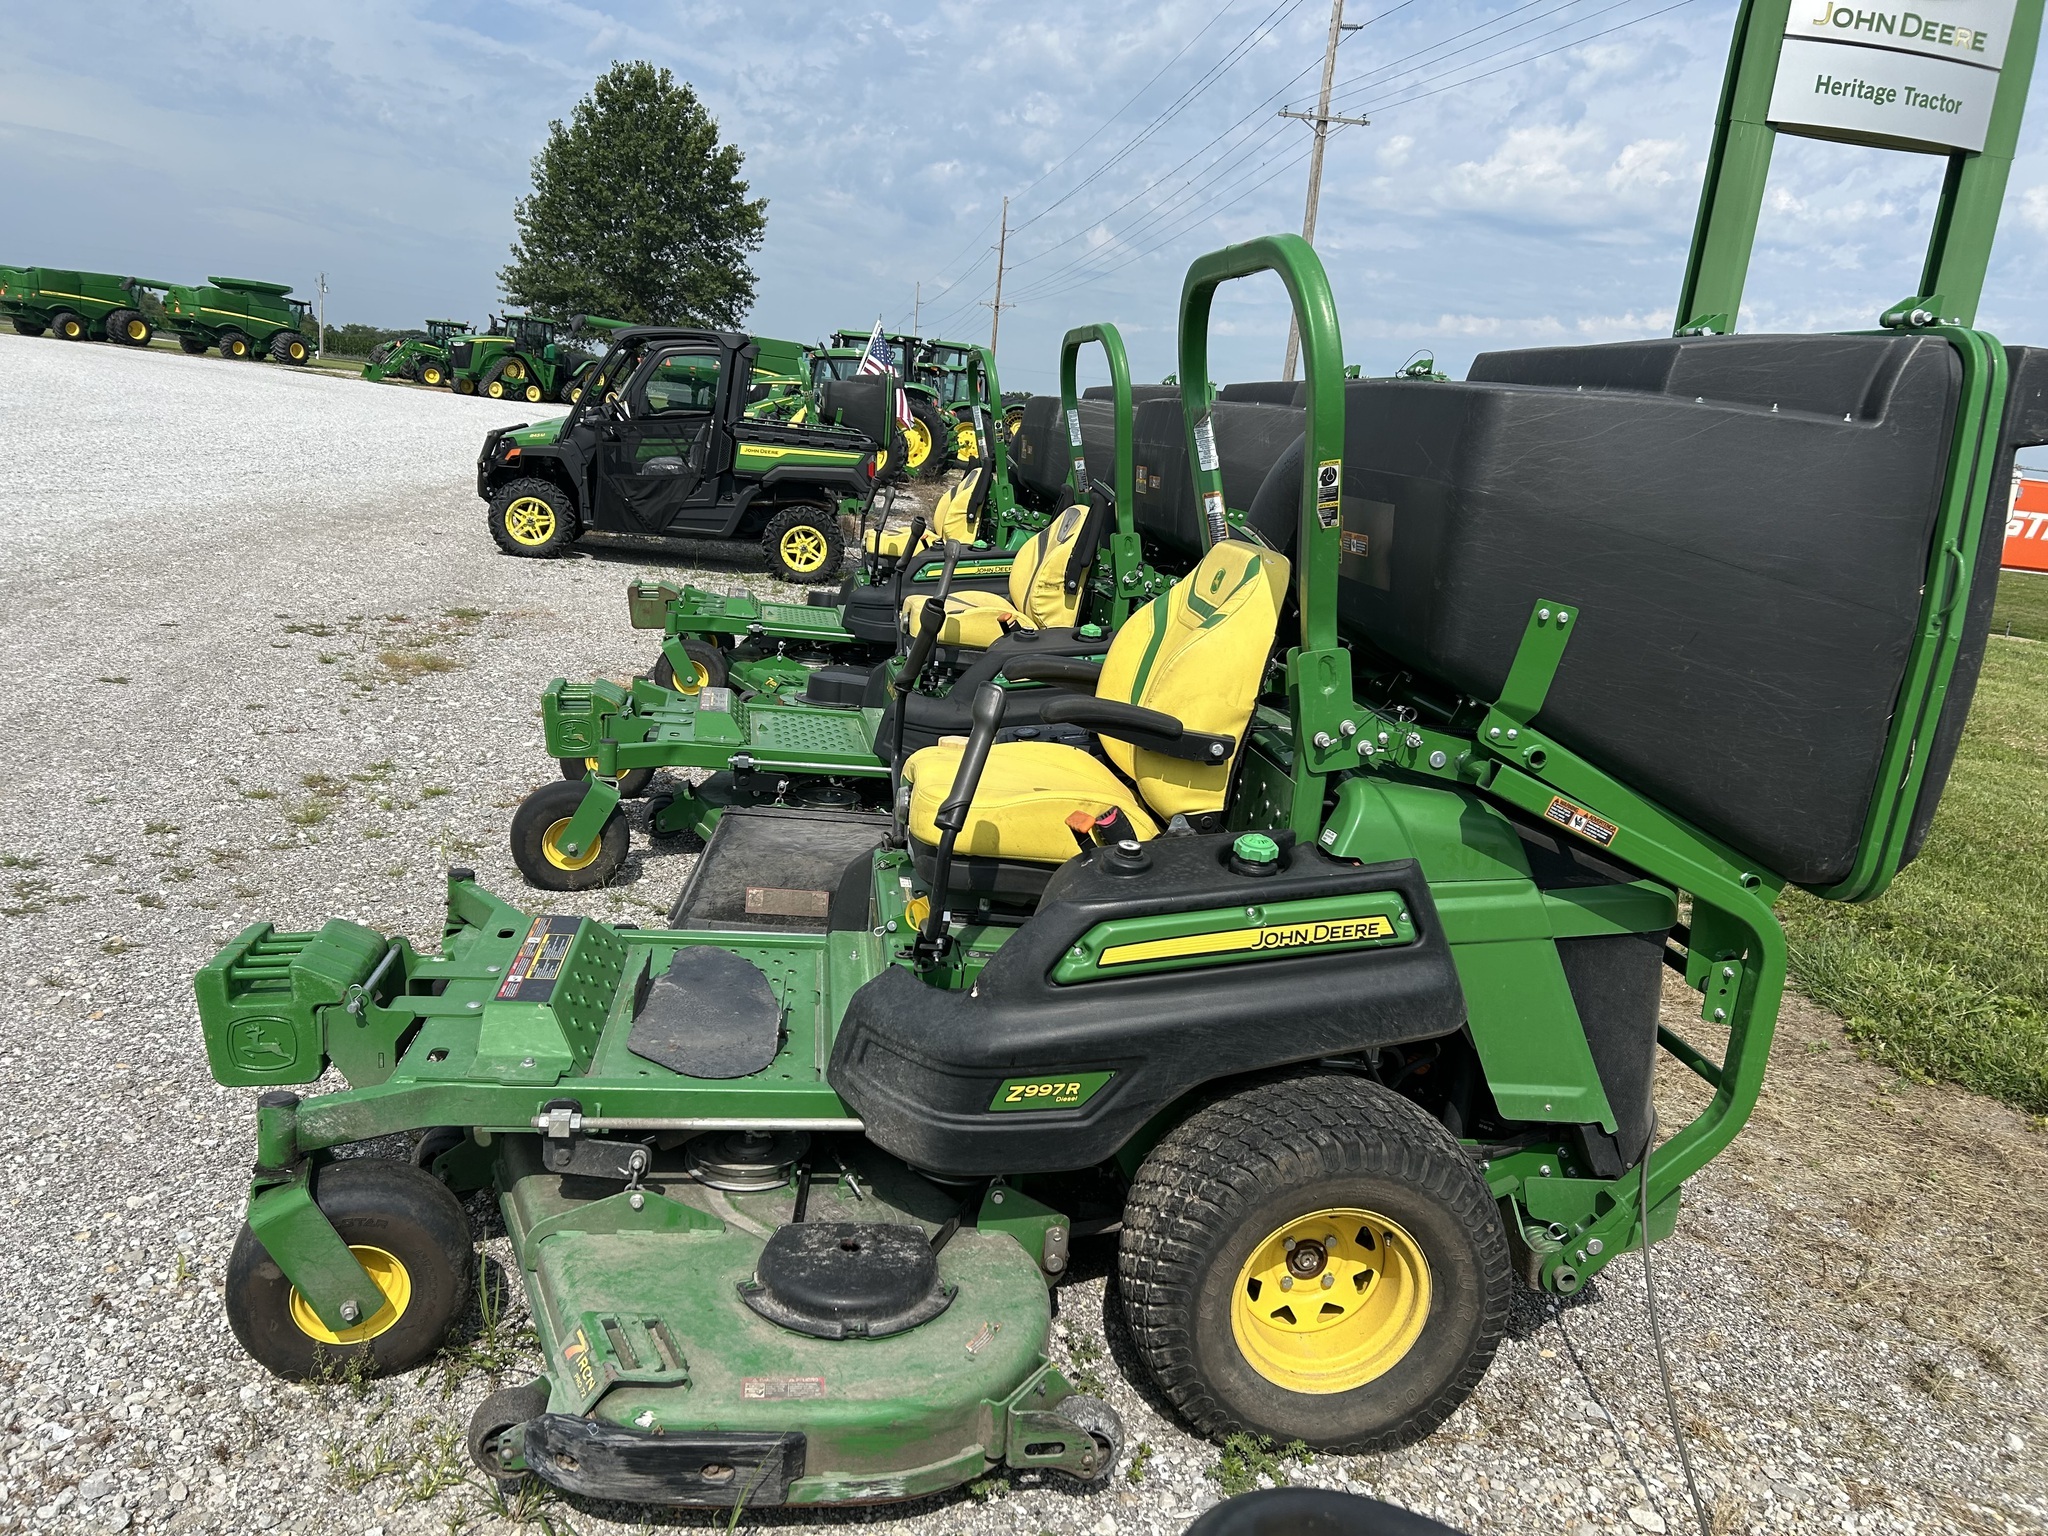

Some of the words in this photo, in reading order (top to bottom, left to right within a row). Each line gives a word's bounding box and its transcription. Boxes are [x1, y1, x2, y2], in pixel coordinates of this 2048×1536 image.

[1812, 1, 1897, 36] JOHN
[1899, 12, 1989, 53] DEERE
[1814, 74, 1897, 106] Heritage
[1904, 85, 1963, 115] Tractor
[2007, 510, 2048, 541] ST
[975, 566, 994, 574] JOHN
[1251, 928, 1309, 949] JOHN
[1313, 922, 1380, 942] DEERE
[1200, 1220, 1261, 1320] KENDA
